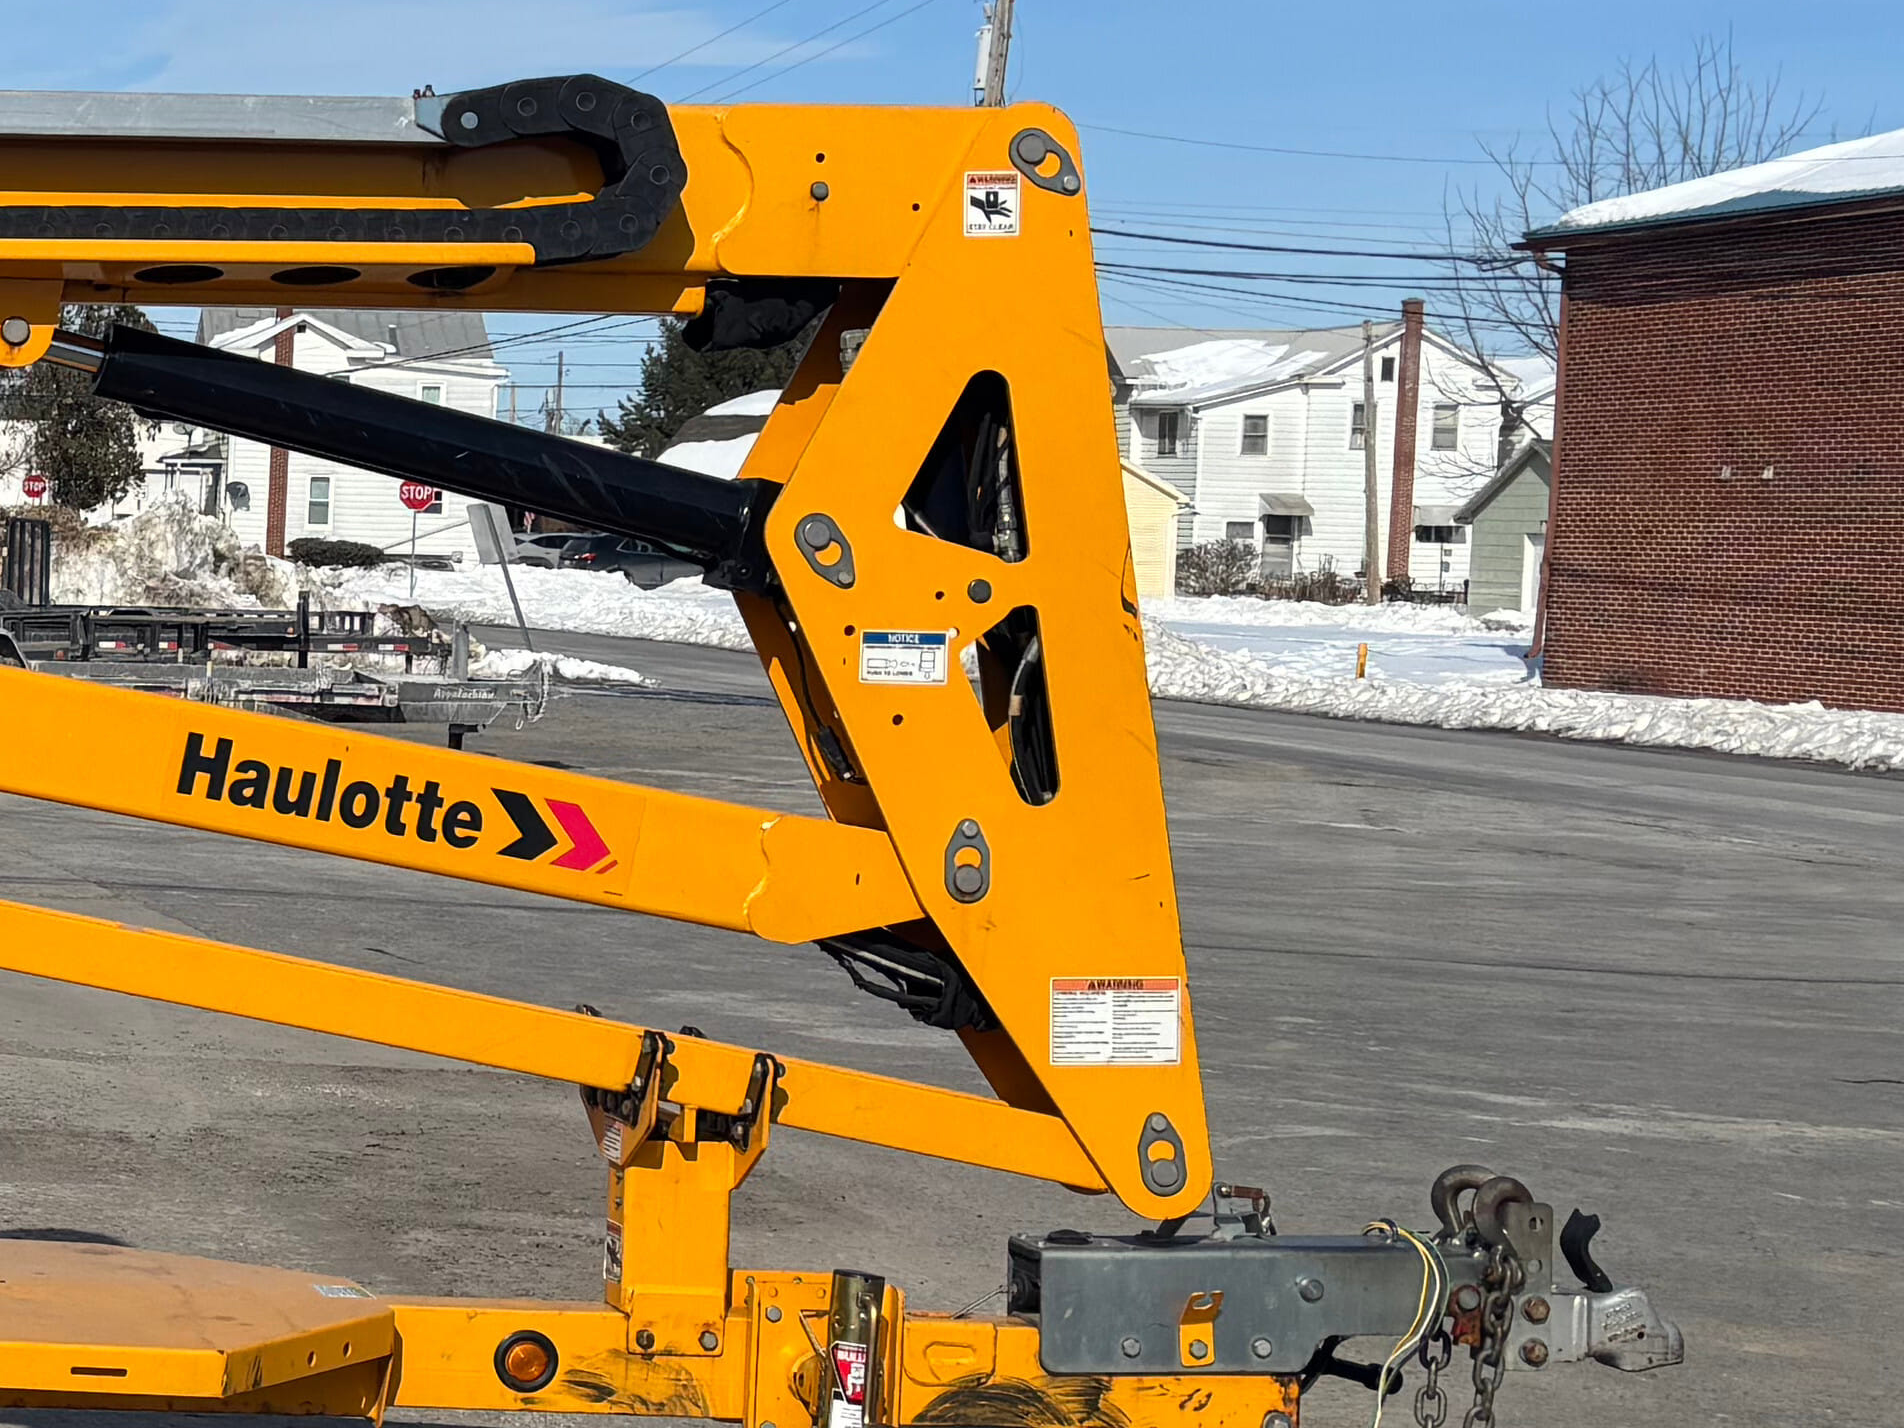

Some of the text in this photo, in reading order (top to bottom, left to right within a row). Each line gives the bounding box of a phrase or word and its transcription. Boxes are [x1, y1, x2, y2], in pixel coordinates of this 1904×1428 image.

[24, 481, 44, 492] STOP
[402, 485, 433, 500] STOP
[888, 634, 920, 644] NOTICE
[176, 731, 483, 849] Haulotte
